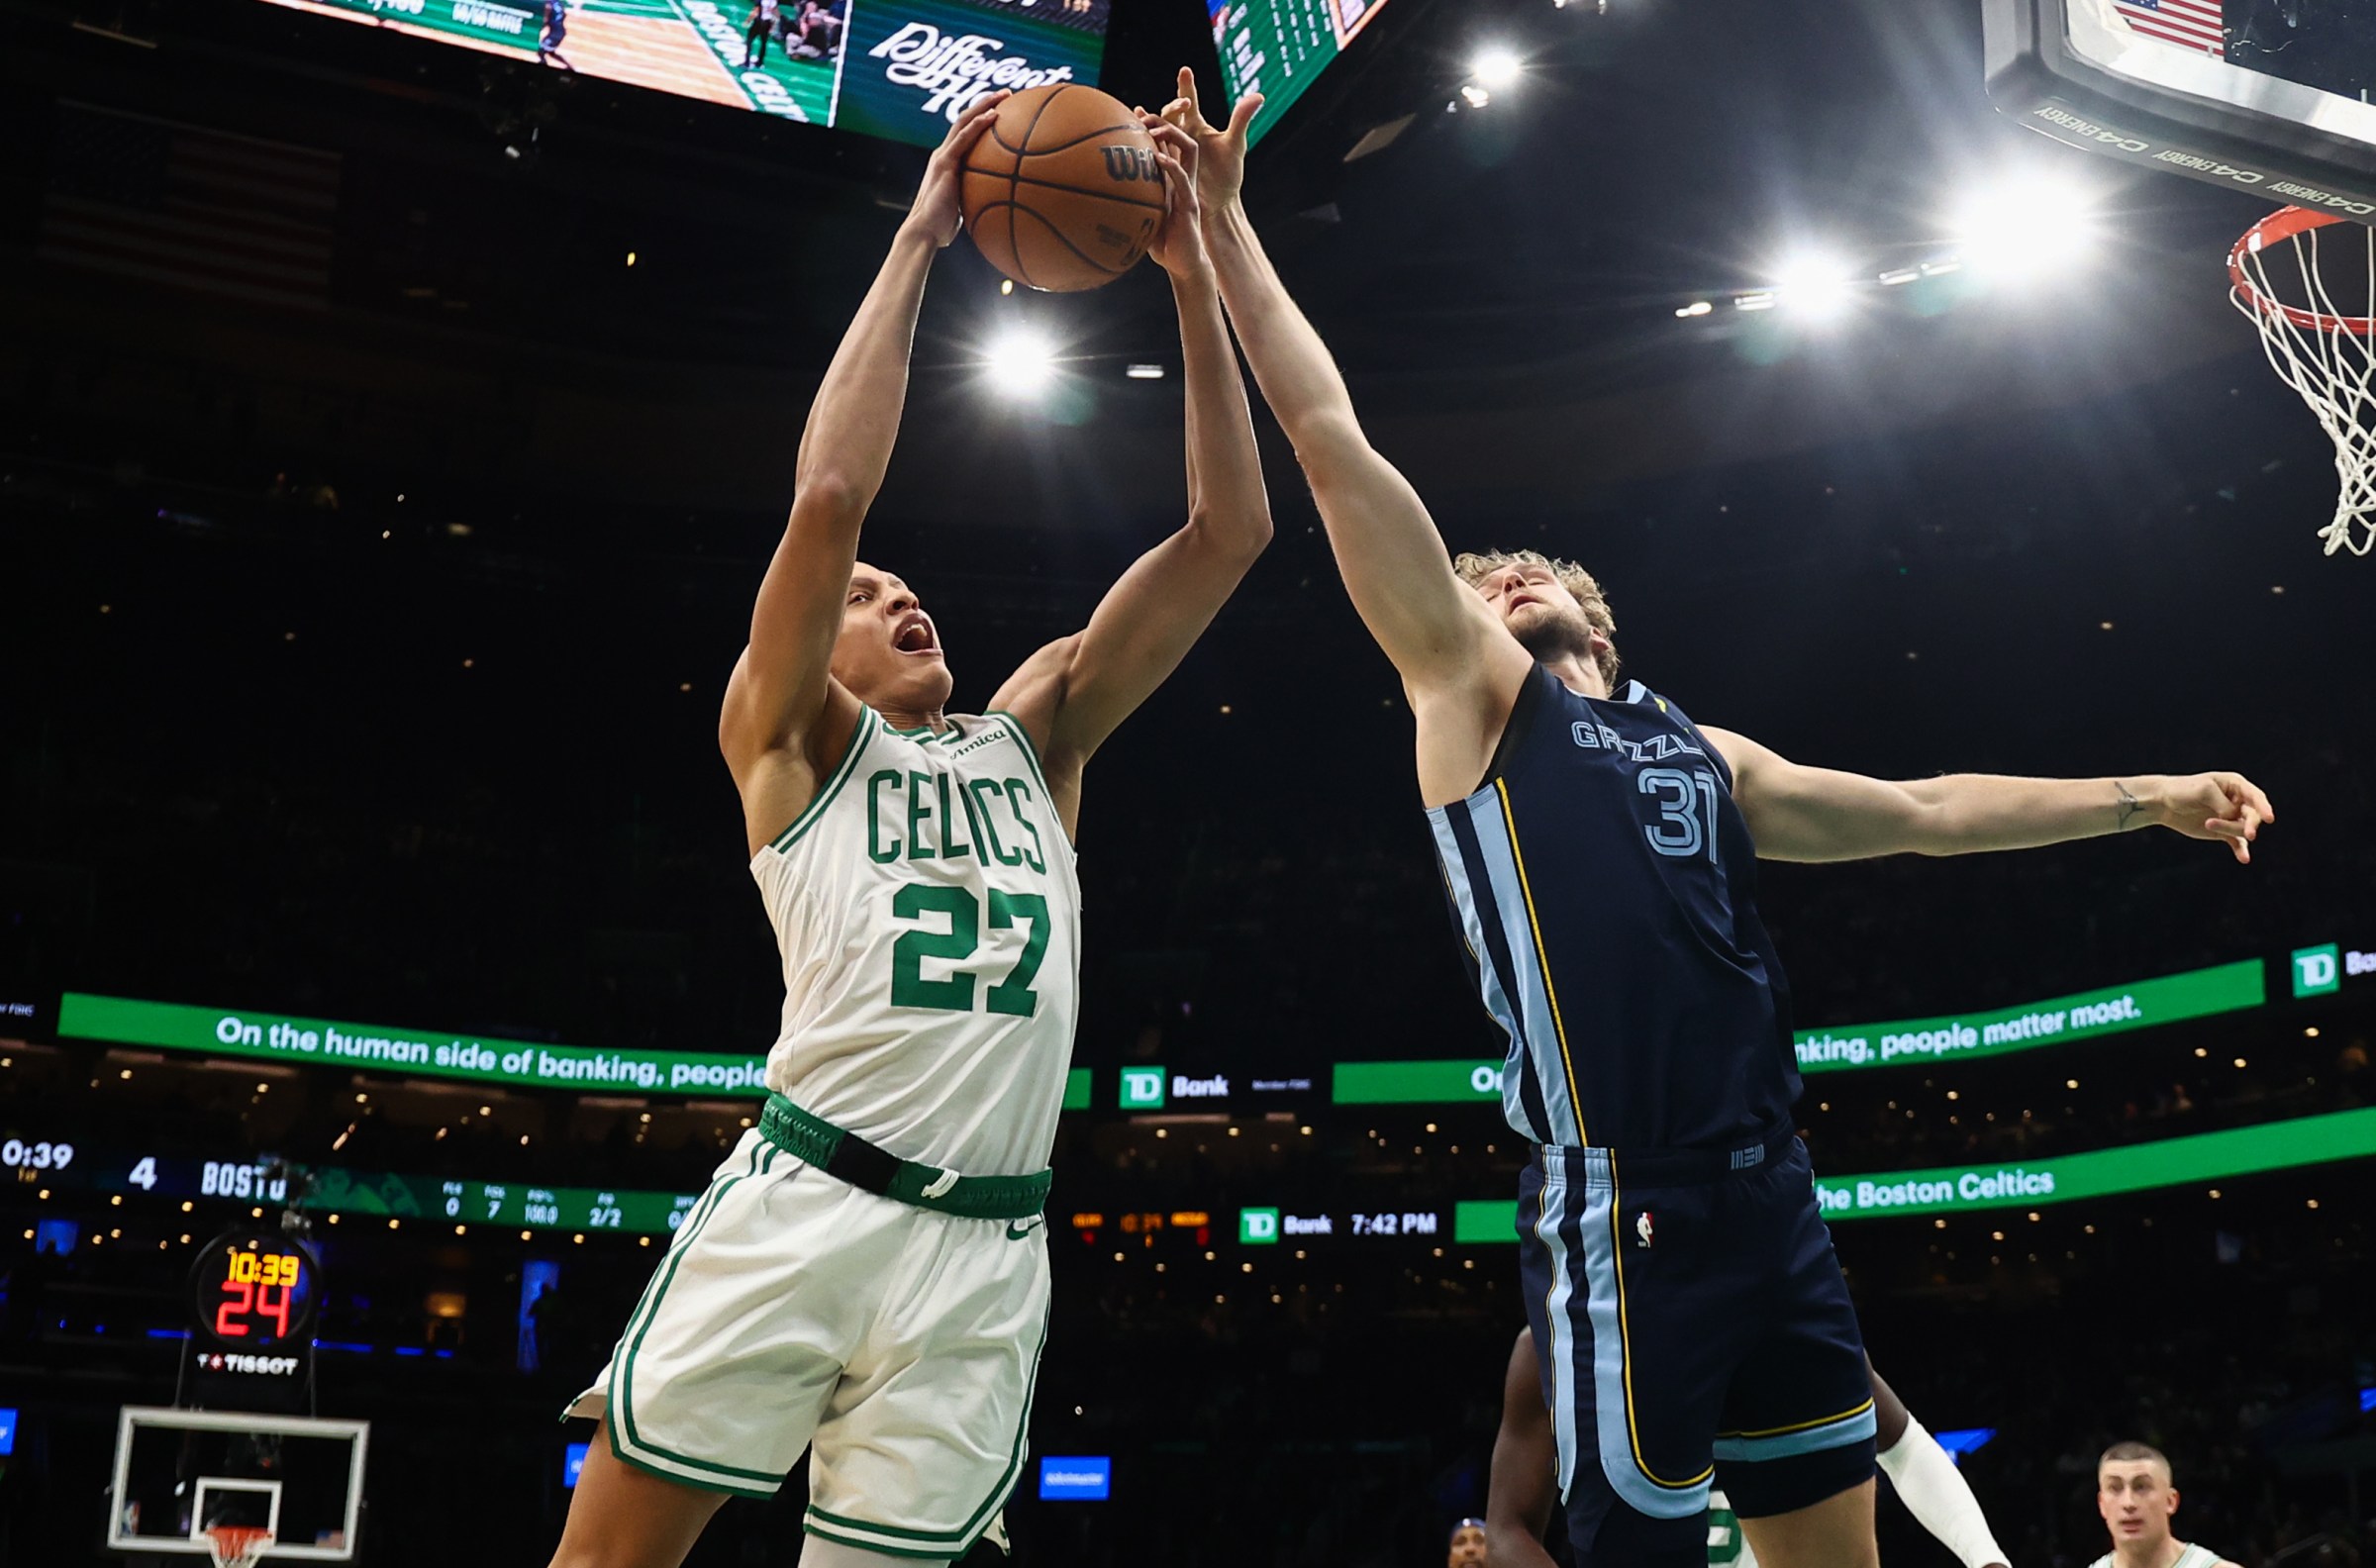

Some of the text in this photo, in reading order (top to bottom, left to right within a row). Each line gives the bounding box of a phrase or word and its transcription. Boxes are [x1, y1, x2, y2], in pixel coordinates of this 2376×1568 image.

[868, 22, 1073, 90] Different
[2033, 106, 2101, 138] ENERGY
[1100, 145, 1164, 183] Wil
[2152, 149, 2217, 172] ENERGY
[2265, 181, 2331, 202] ENERGY
[950, 730, 1006, 760] Amica
[867, 768, 1047, 876] CELICS
[1636, 767, 1719, 865] 31
[890, 882, 1051, 1019] 27
[2295, 950, 2376, 988] TD Ba
[1794, 995, 2141, 1065] nking, people matter most.
[215, 1016, 262, 1047] On
[268, 1022, 320, 1052] the
[324, 1027, 430, 1064] human
[435, 1040, 498, 1071] side
[501, 1048, 534, 1075] of
[537, 1049, 665, 1088] banking,
[1124, 1073, 1230, 1102] TD Bank
[1, 1138, 74, 1170] 0:39
[128, 1156, 157, 1191] 4
[200, 1161, 287, 1202] BOSTO
[1816, 1169, 2055, 1211] he Boston Celtics
[446, 1196, 460, 1217] 0
[487, 1200, 502, 1220] 7
[589, 1207, 623, 1227] 2/2
[1351, 1212, 1437, 1235] 7:42 PM
[1243, 1213, 1333, 1238] TD Bank
[228, 1250, 300, 1287] 10:39
[216, 1280, 291, 1338] 24
[224, 1353, 299, 1376] TISSOT
